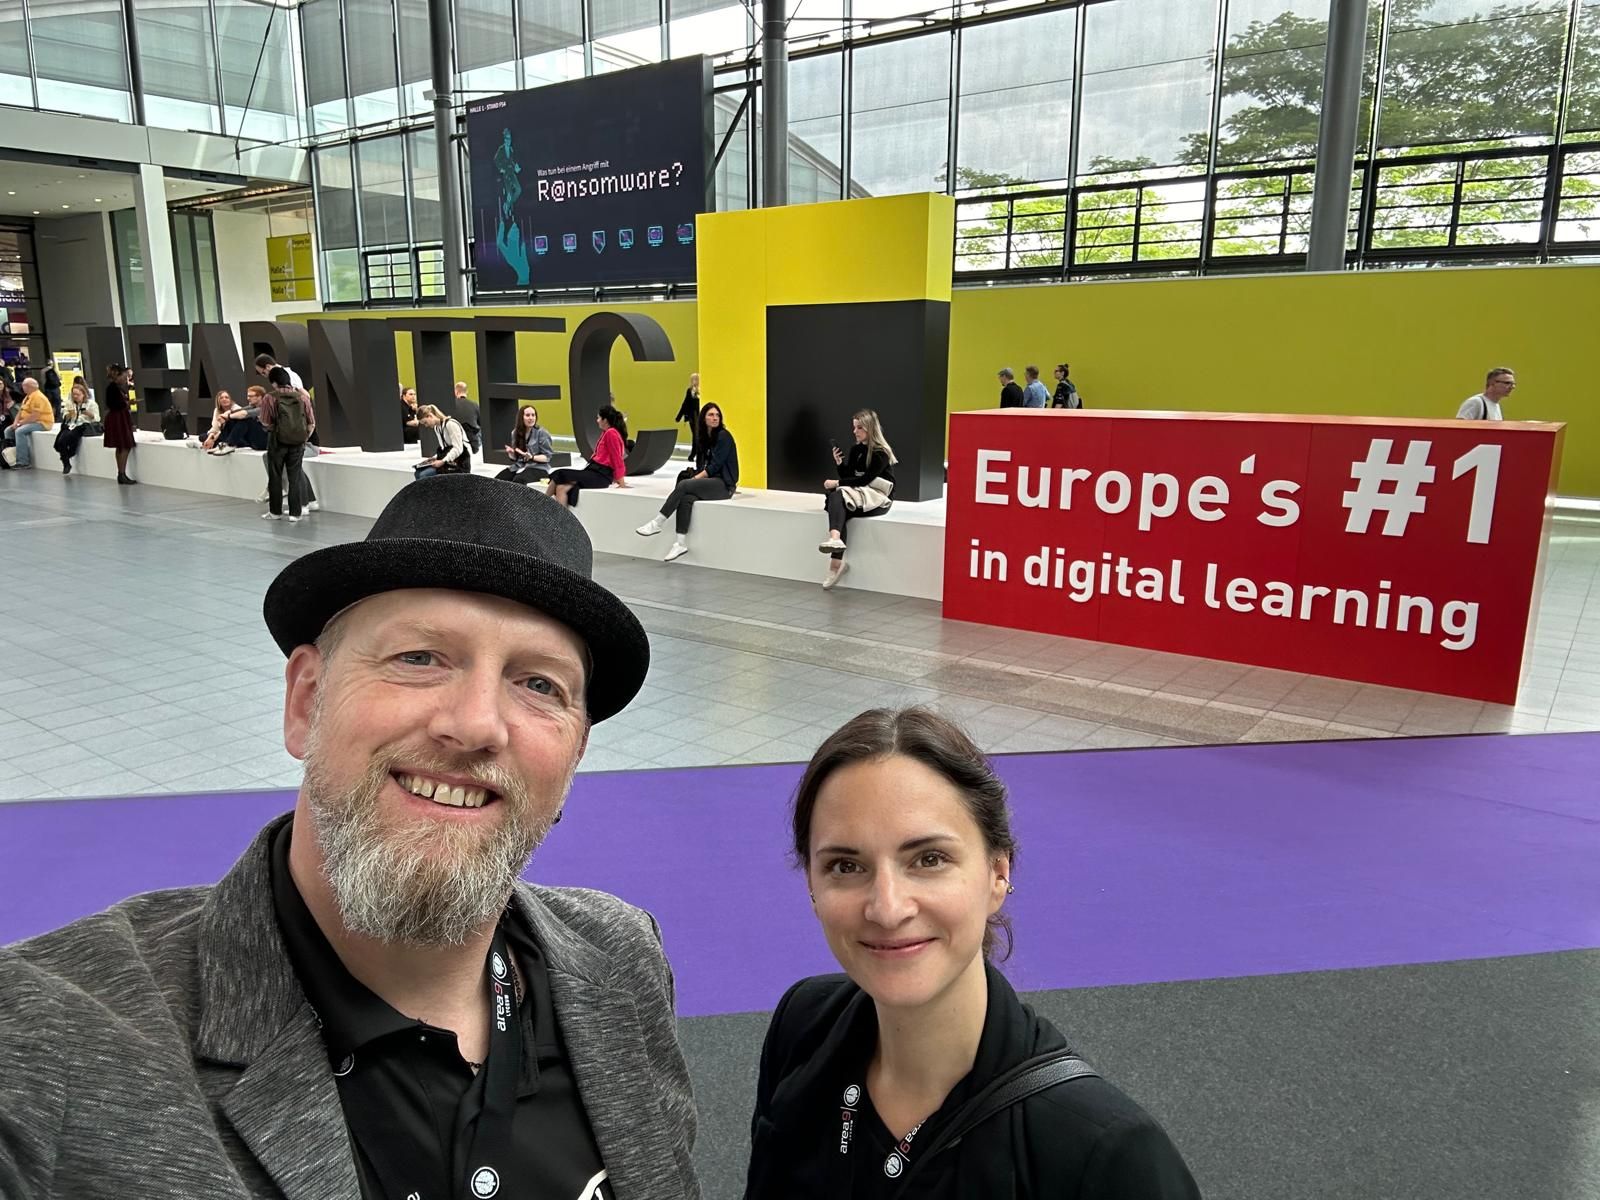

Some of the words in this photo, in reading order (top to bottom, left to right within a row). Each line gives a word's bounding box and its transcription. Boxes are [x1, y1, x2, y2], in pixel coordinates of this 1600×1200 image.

[537, 169, 548, 177] Was
[548, 167, 557, 175] tun
[557, 166, 566, 174] bei
[566, 164, 582, 173] einem
[582, 160, 600, 172] Angriff
[600, 160, 610, 168] mit
[538, 162, 683, 202] R@nsomware?
[1342, 439, 1501, 543] #1
[970, 539, 1007, 581] in
[1024, 546, 1184, 604] digital
[1205, 563, 1478, 650] learning
[494, 982, 507, 1032] area9
[840, 1110, 851, 1154] area9
